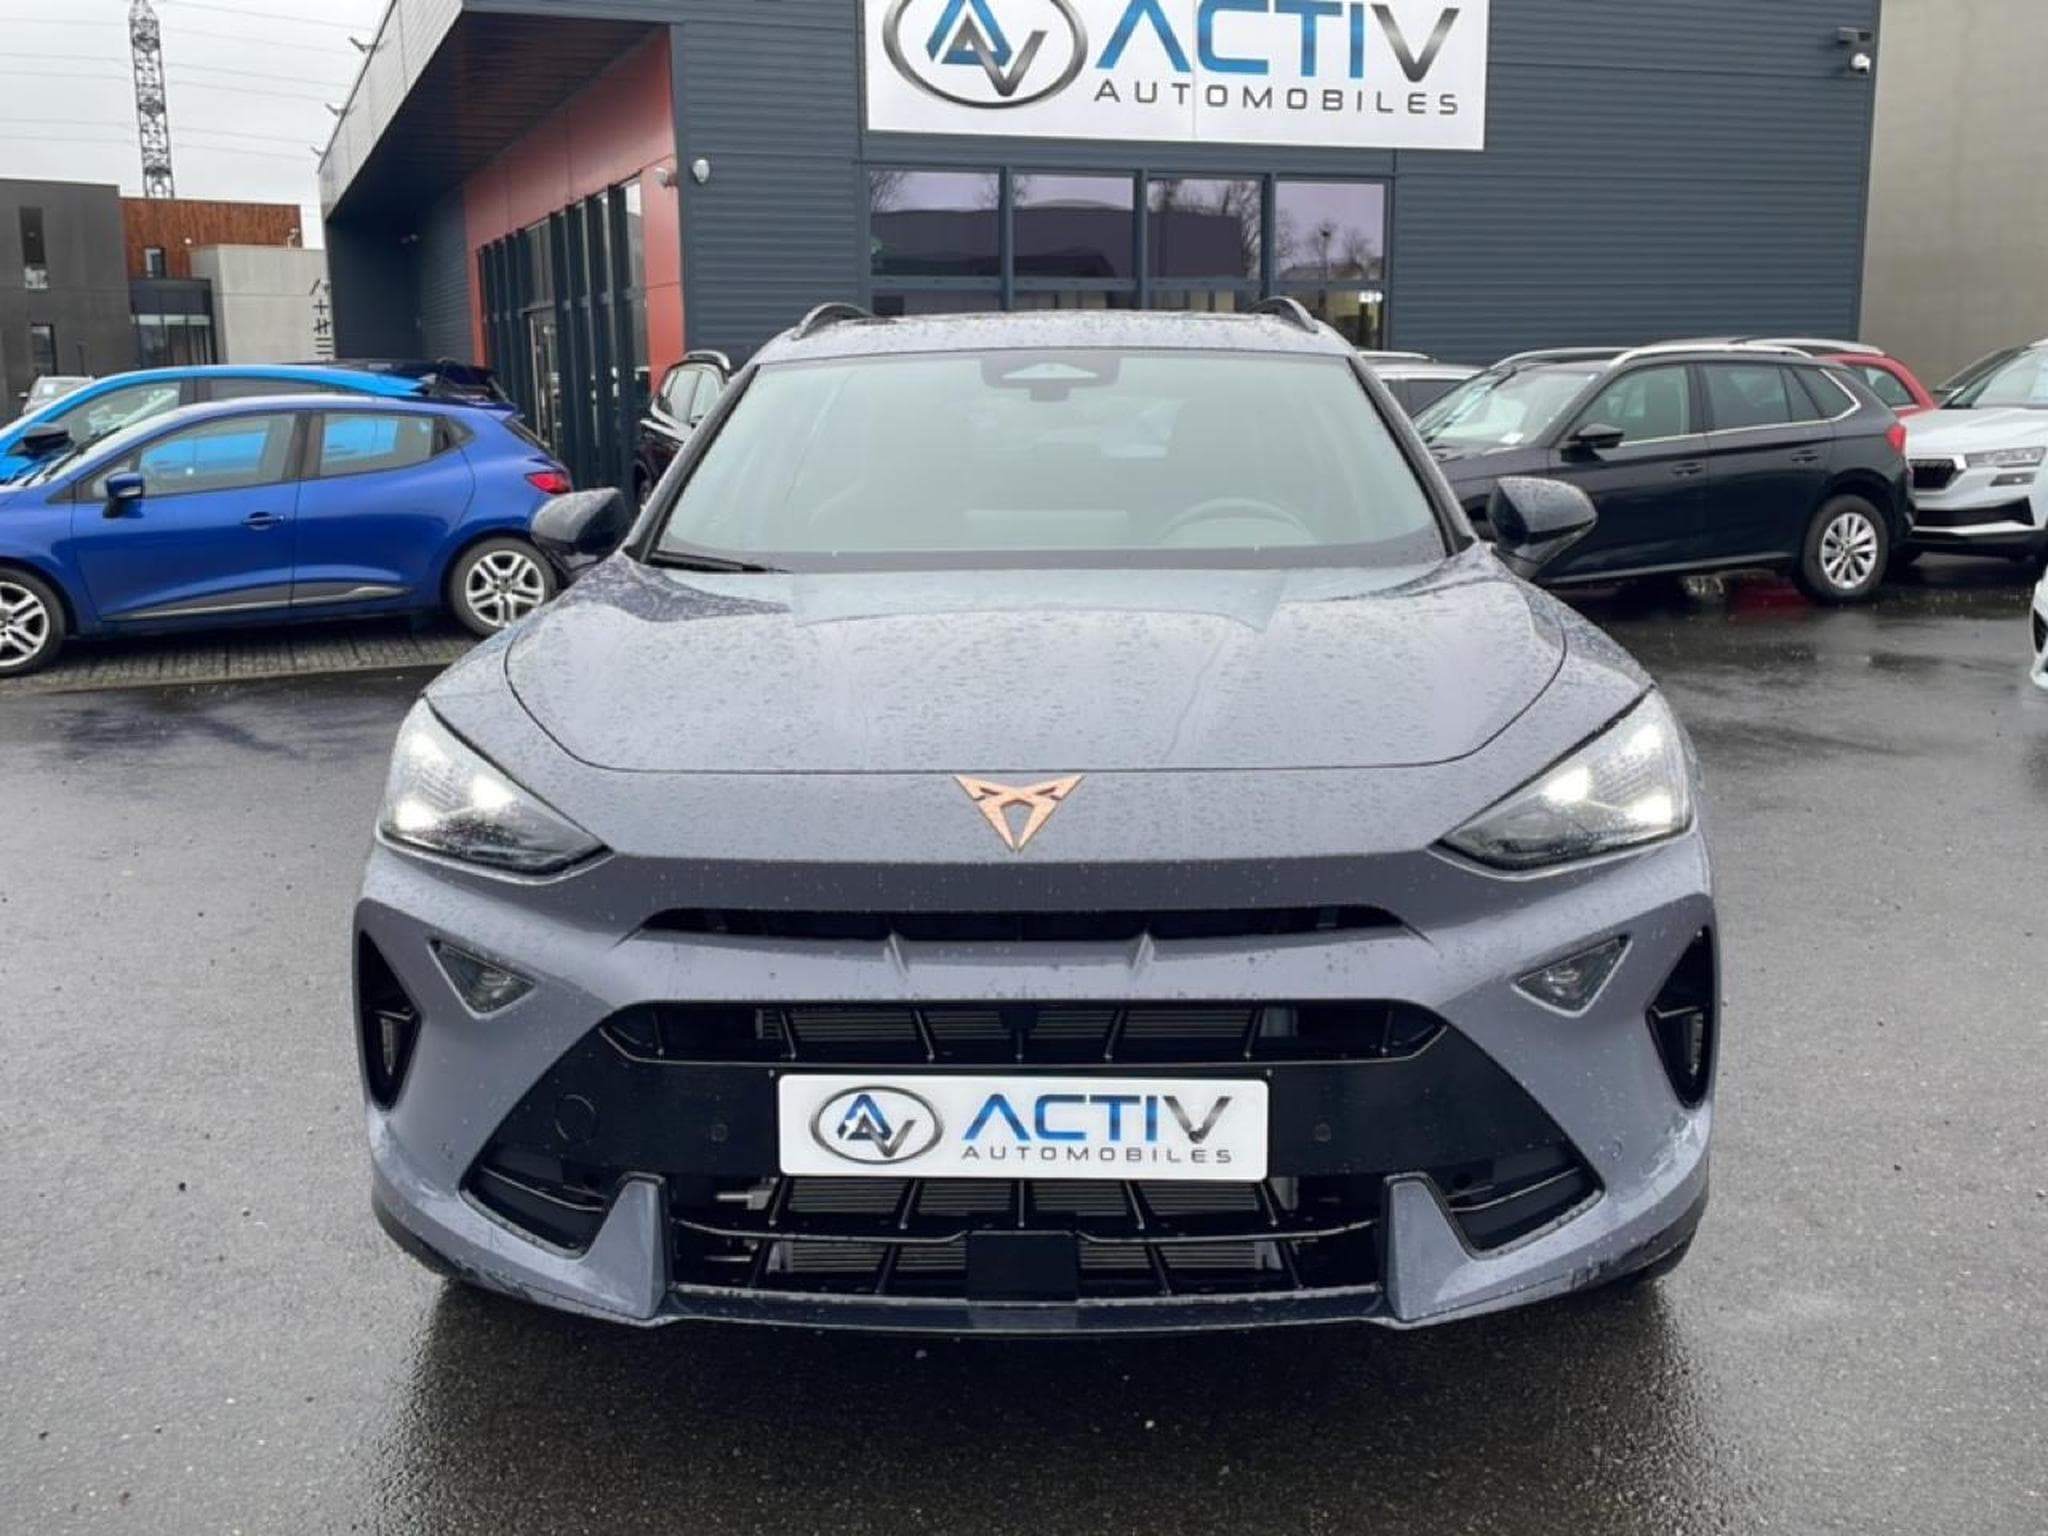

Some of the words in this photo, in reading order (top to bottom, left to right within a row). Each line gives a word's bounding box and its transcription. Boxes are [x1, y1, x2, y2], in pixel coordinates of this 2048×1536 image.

[1095, 0, 1460, 82] ACTIV
[1094, 79, 1459, 115] AUTOMOBILES
[963, 1094, 1232, 1143] ACTIV
[962, 1146, 1232, 1164] AUTOMOBILES
